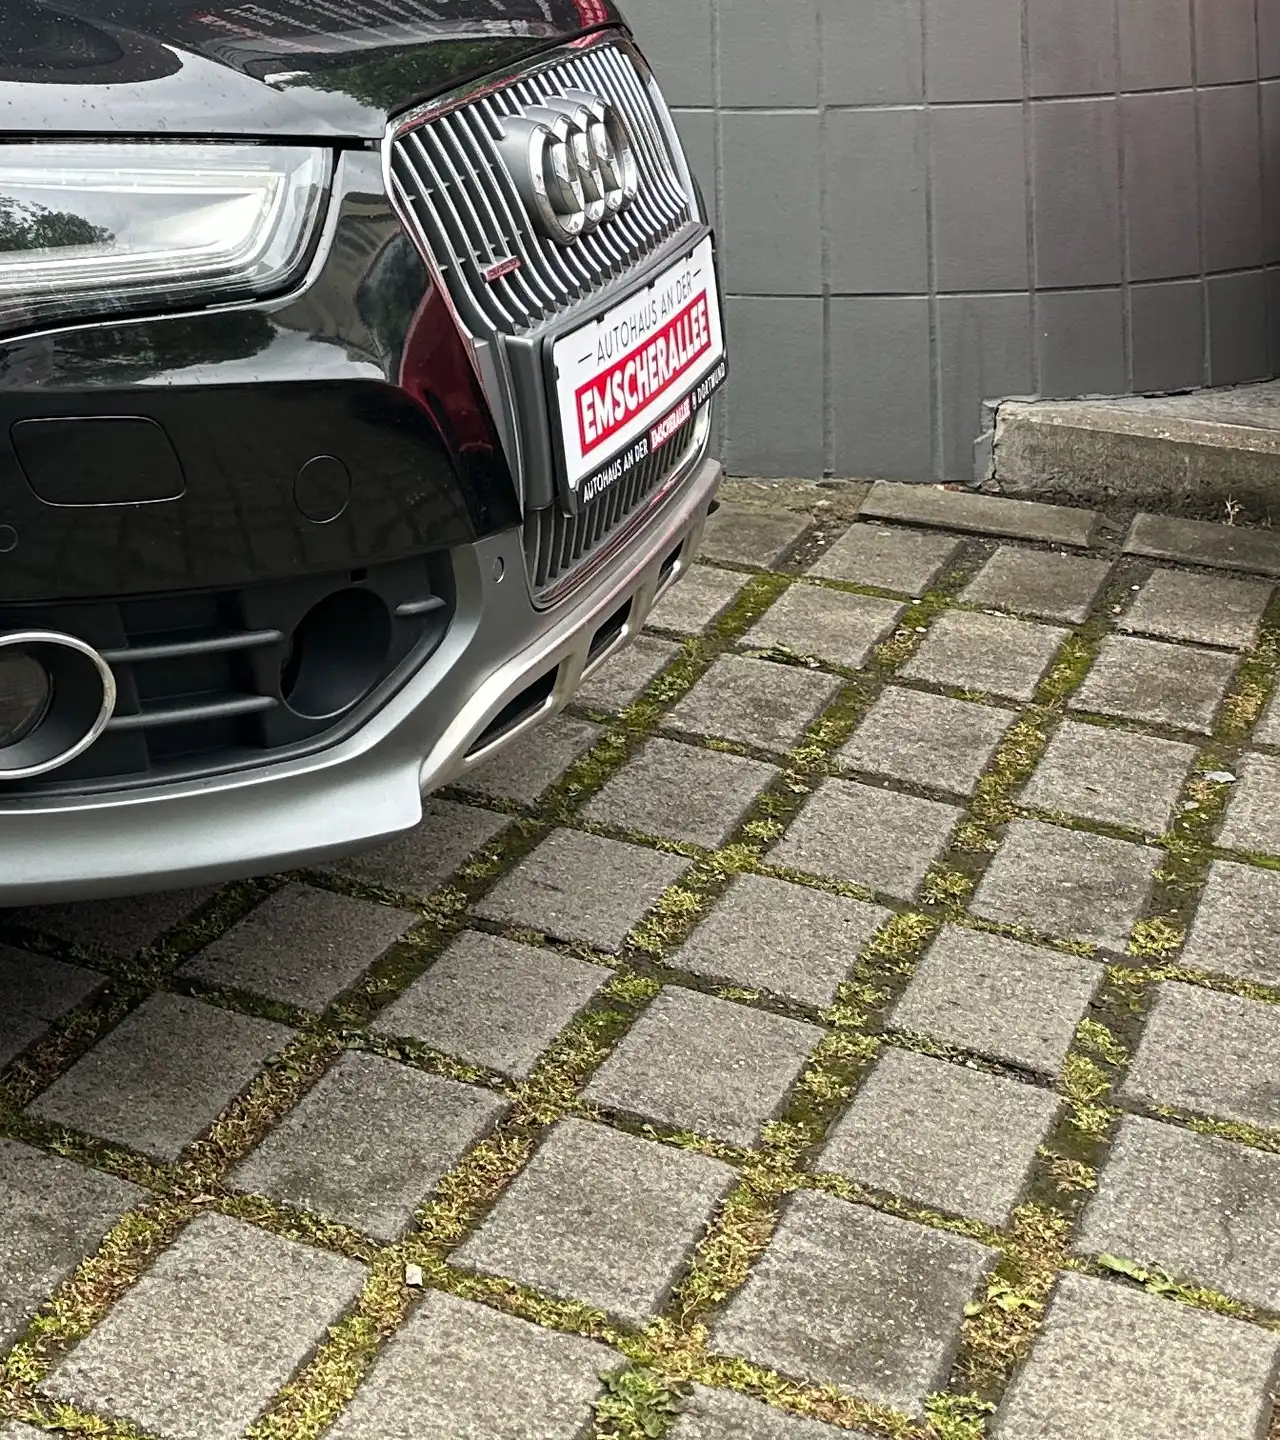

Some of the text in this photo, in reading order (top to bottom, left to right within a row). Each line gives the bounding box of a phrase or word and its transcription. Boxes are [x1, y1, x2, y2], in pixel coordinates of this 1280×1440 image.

[580, 298, 709, 445] EMSCHERALLEE
[597, 271, 693, 366] AUTOHAUS AN DER
[583, 462, 622, 504] AUTOHAUS
[624, 449, 634, 472] AN
[634, 438, 648, 462] DER
[650, 398, 691, 449] EMSCHERALLEE
